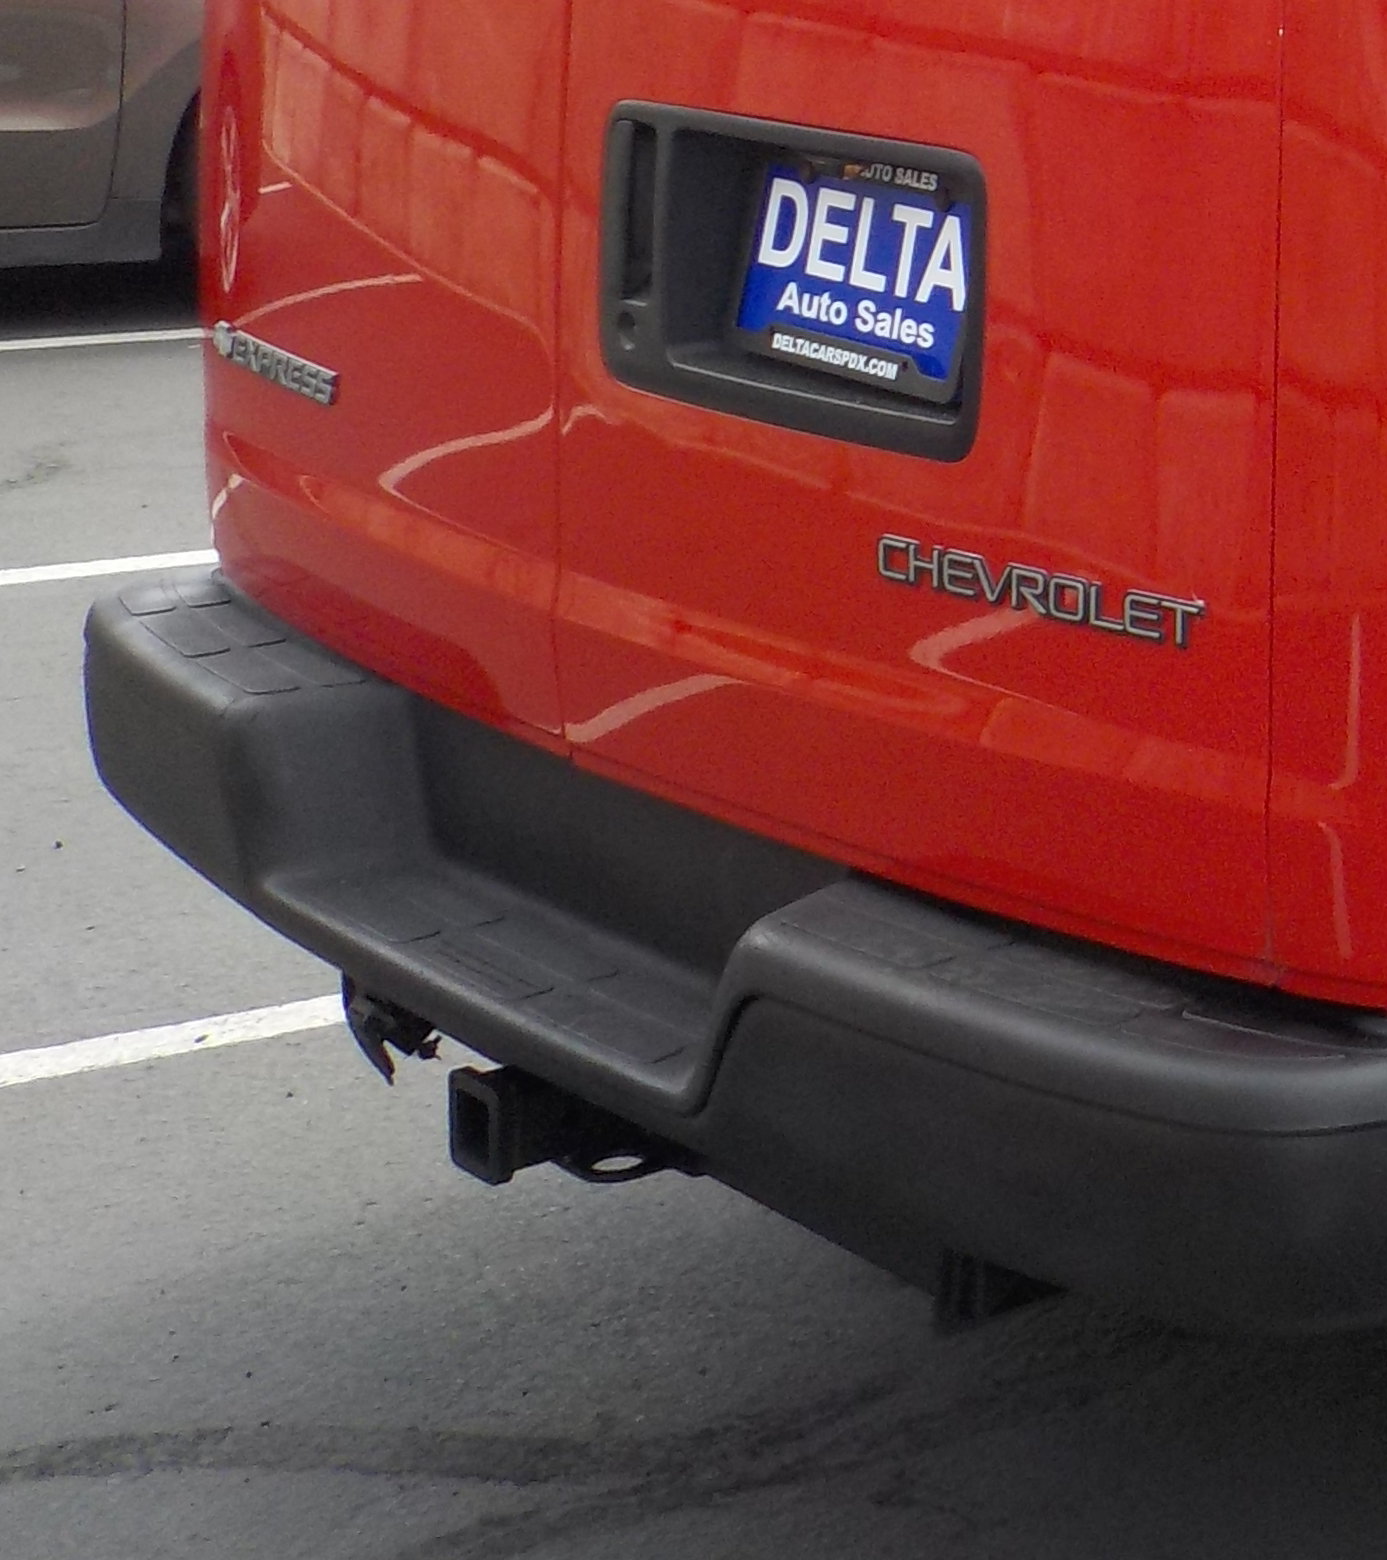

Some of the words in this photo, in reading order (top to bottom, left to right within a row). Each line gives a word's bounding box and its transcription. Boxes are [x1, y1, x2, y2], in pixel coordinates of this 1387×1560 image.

[894, 167, 939, 191] SALES
[757, 177, 967, 313] DELTA
[776, 281, 848, 326] Auto
[854, 299, 936, 349] Sales
[232, 334, 335, 406] EXPRESS
[771, 332, 899, 381] DELTACARSPDX.COM
[876, 533, 1207, 650] CHEVROLET
